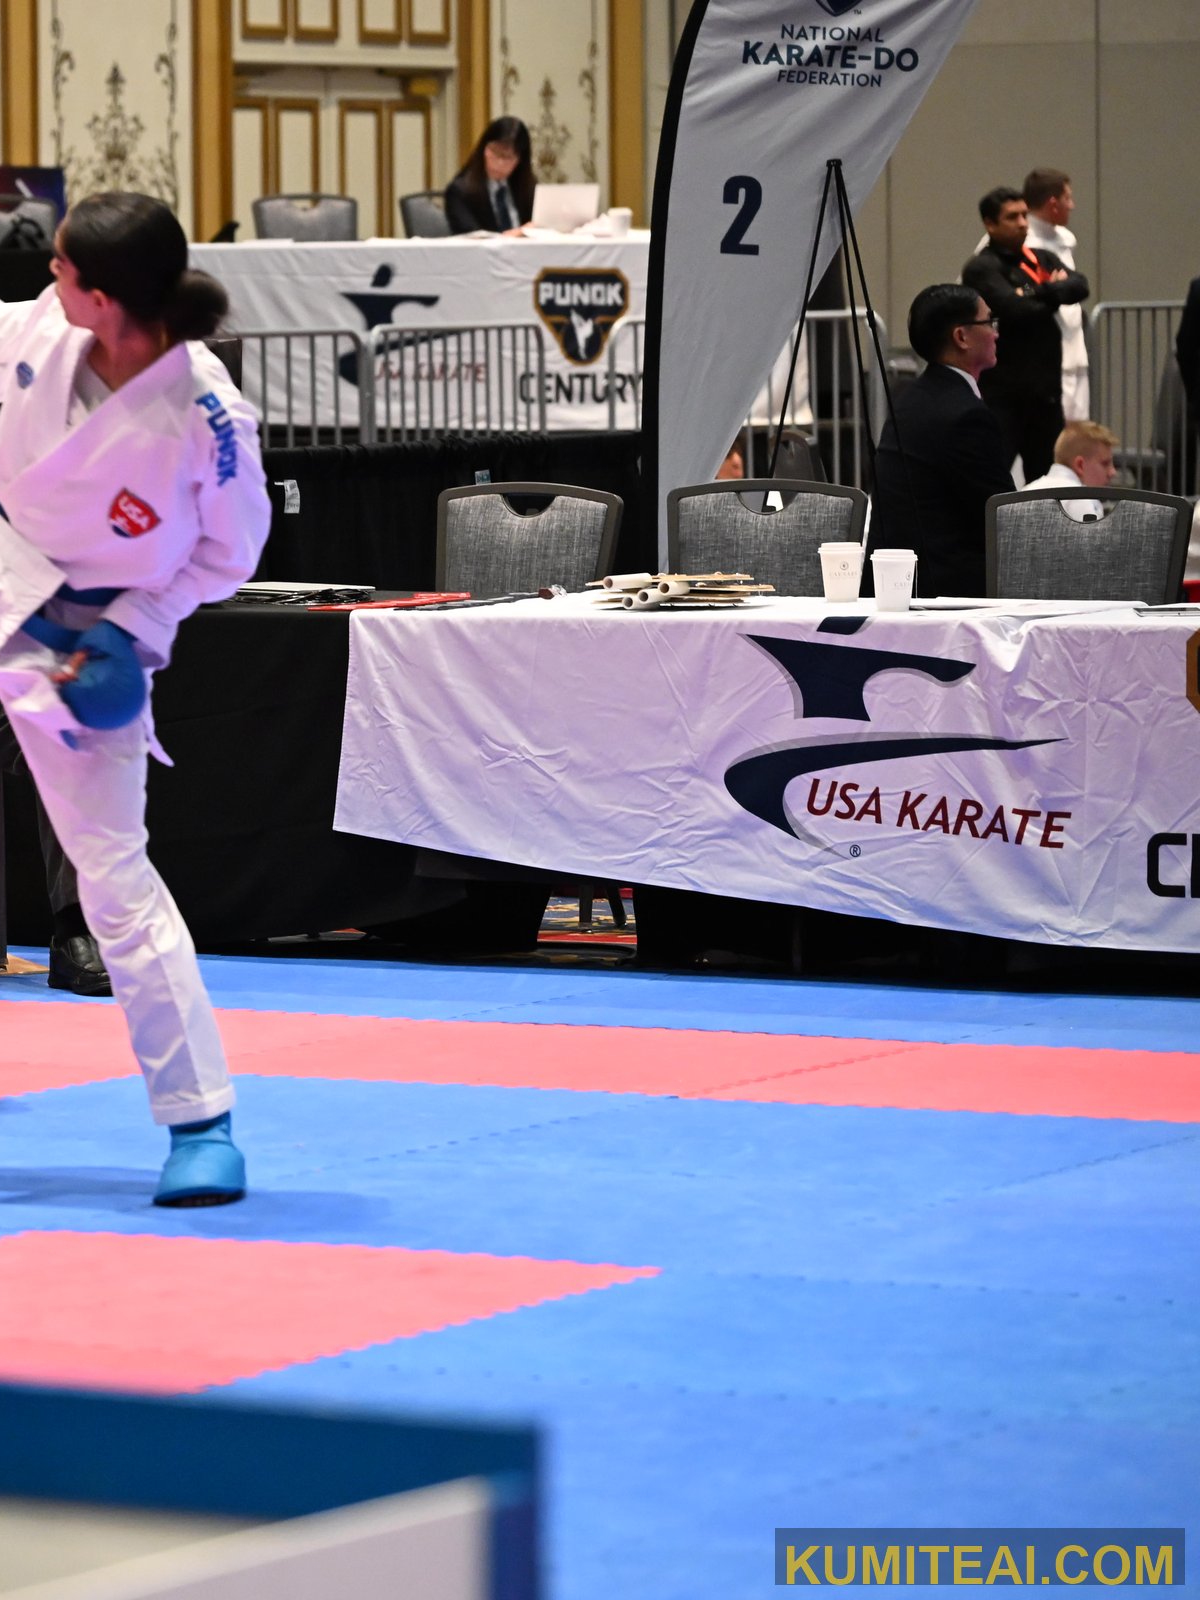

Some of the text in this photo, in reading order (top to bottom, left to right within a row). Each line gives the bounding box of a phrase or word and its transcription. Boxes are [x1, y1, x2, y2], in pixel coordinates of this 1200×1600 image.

[781, 24, 884, 43] NATIONAL
[742, 41, 919, 72] KARATE-DO
[777, 70, 882, 88] FEDERATION
[720, 175, 762, 256] 2
[539, 281, 624, 306] PUNOK
[806, 778, 1072, 849] USA KARATE
[1147, 832, 1200, 898] C
